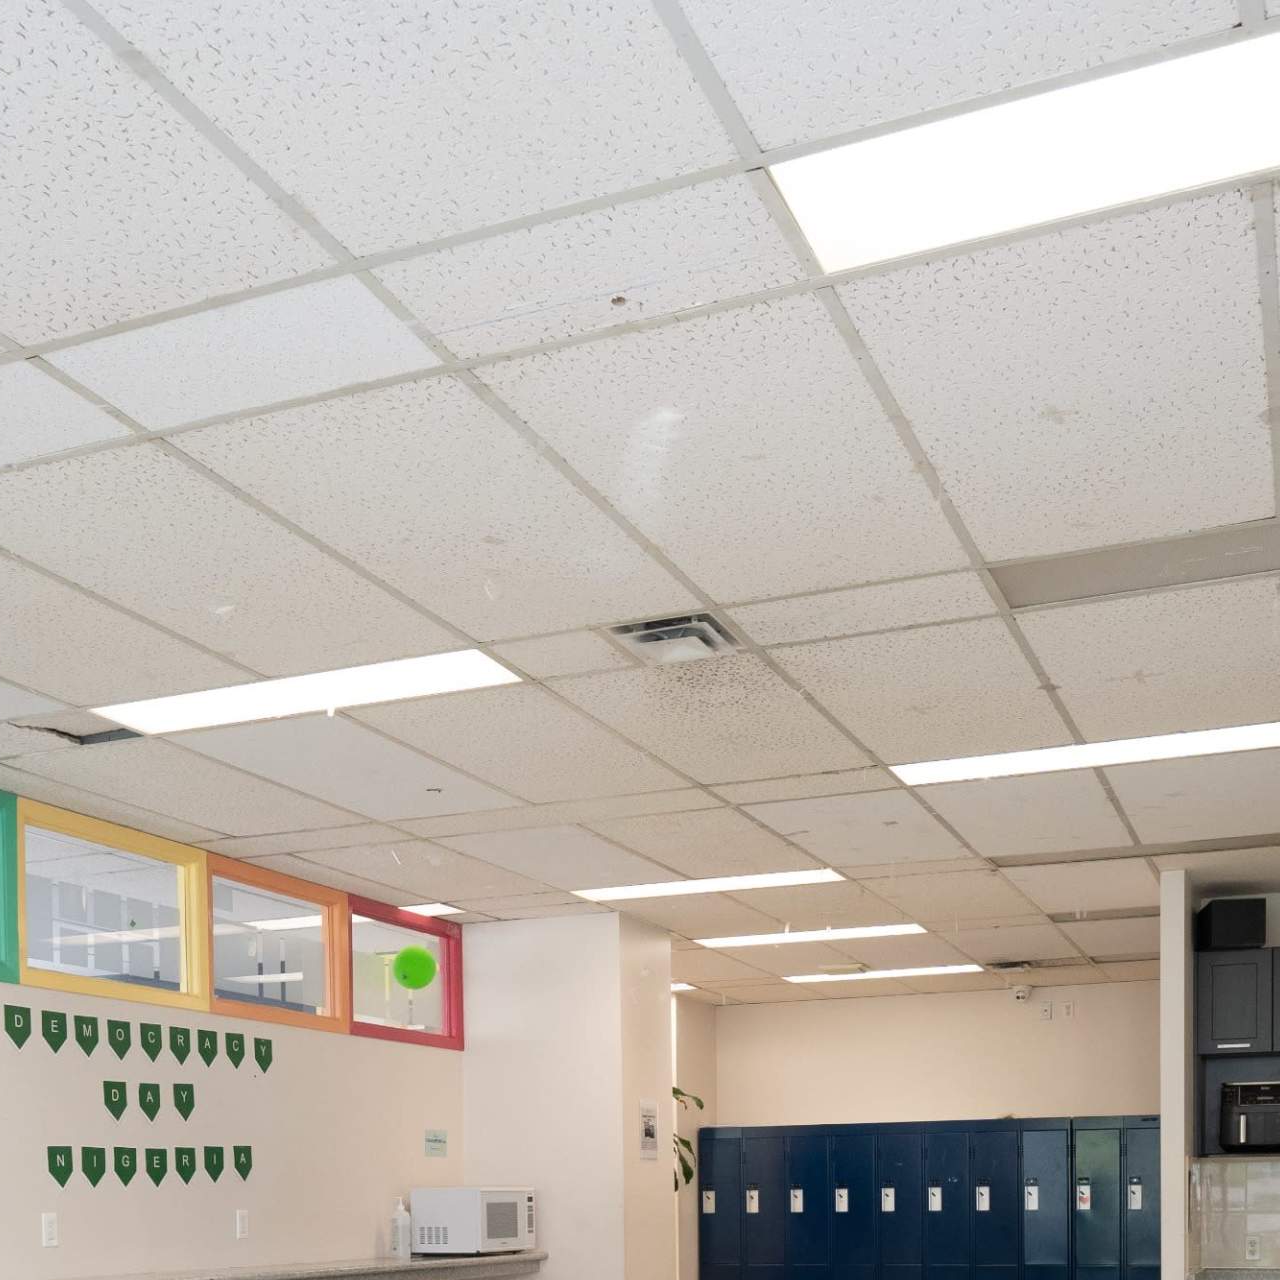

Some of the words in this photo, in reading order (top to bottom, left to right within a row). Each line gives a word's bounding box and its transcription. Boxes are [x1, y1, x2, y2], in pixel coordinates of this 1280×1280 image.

[14, 1014, 267, 1057] DEMOCRACY
[111, 1089, 188, 1103] DAY
[56, 1152, 248, 1169] NIGERIA
